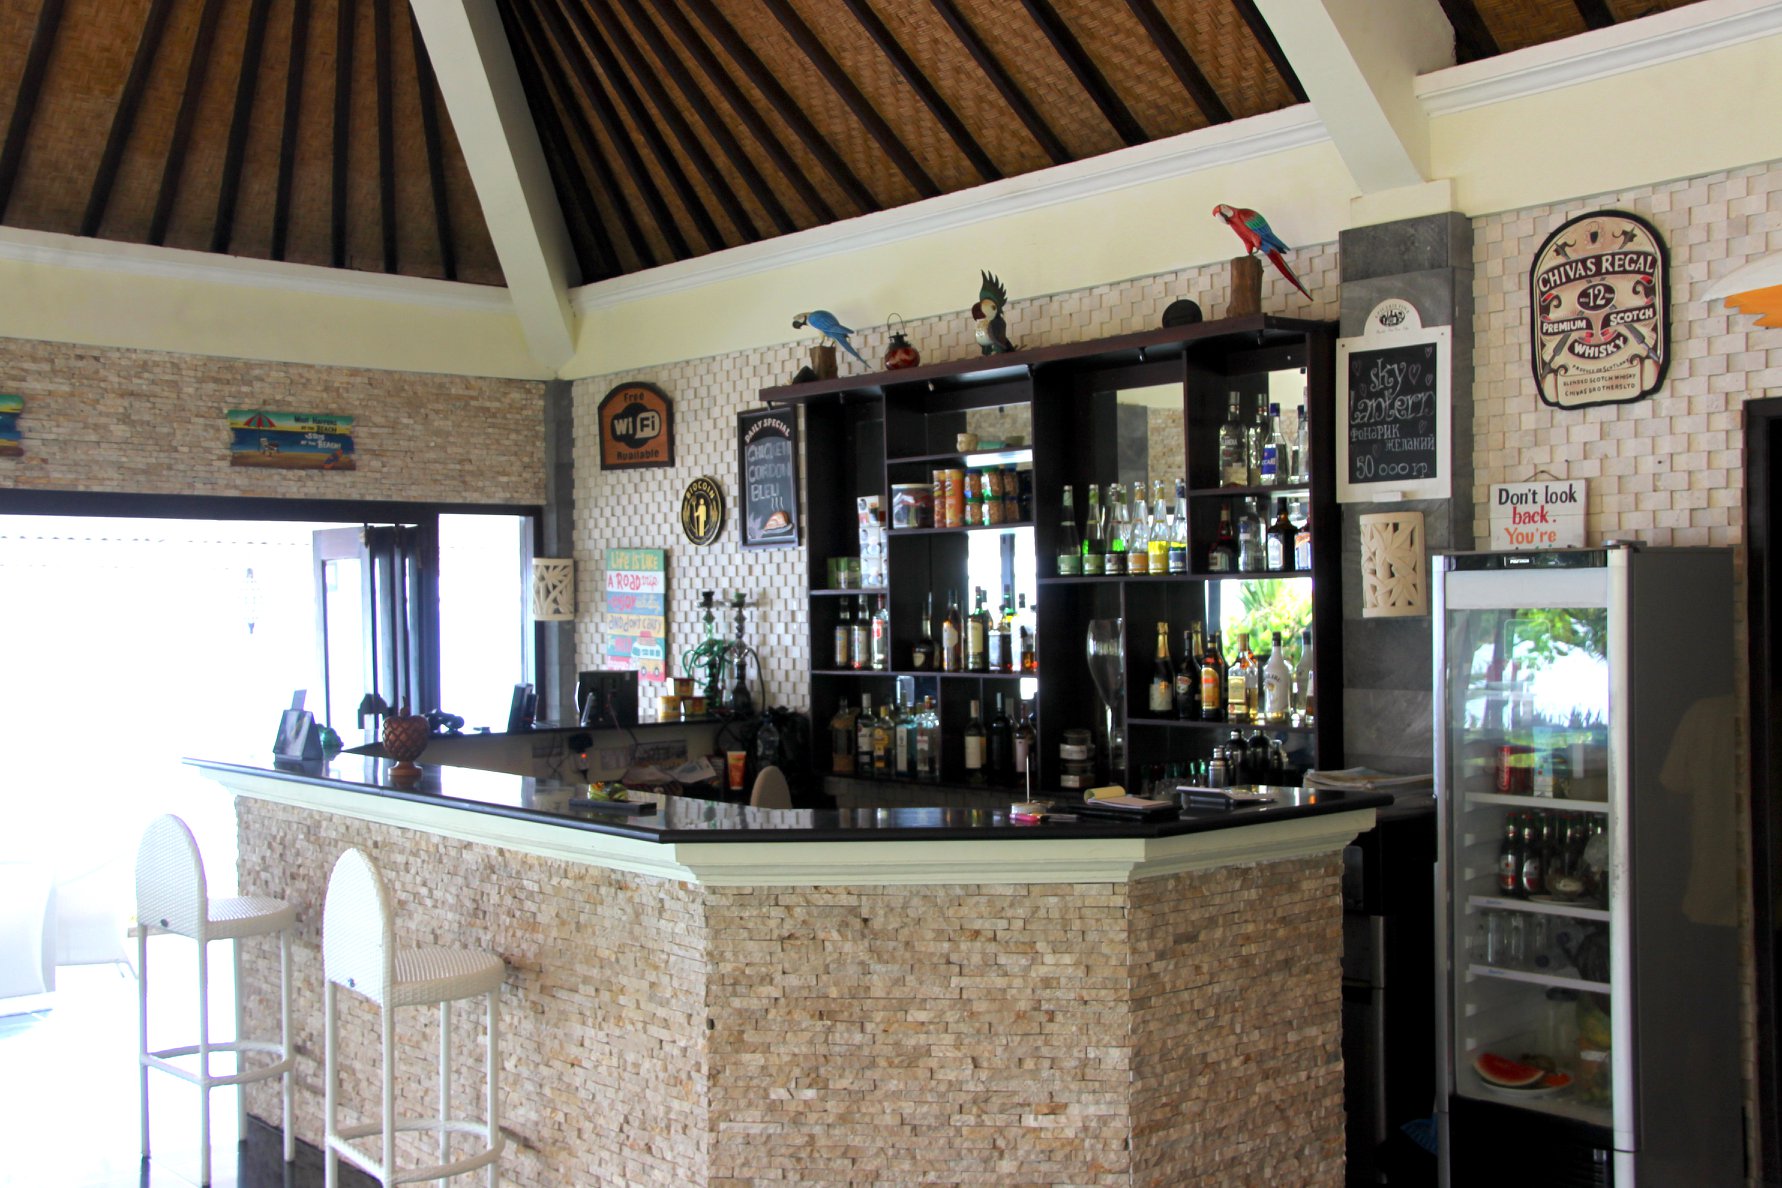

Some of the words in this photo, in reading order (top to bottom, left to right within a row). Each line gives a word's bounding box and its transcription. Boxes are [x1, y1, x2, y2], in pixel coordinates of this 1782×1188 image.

[1539, 258, 1596, 291] CHIVAS
[1601, 254, 1654, 273] REGAL
[1587, 285, 1606, 306] 12
[1609, 308, 1653, 325] SCOTCH
[1542, 319, 1586, 333] PREMIUM
[1573, 337, 1625, 357] WHISKY
[1589, 376, 1613, 384] SCOTCH
[623, 392, 645, 402] Free
[1565, 388, 1587, 396] CHIVAS
[1589, 384, 1623, 394] BROTHERS
[744, 420, 763, 444] DAILY
[762, 417, 791, 437] SPECIAL
[616, 449, 660, 460] Available
[1356, 455, 1375, 479] 50
[750, 483, 780, 502] BLEU
[1498, 488, 1538, 505] Don't
[1544, 483, 1578, 504] look
[1504, 528, 1557, 545] You're
